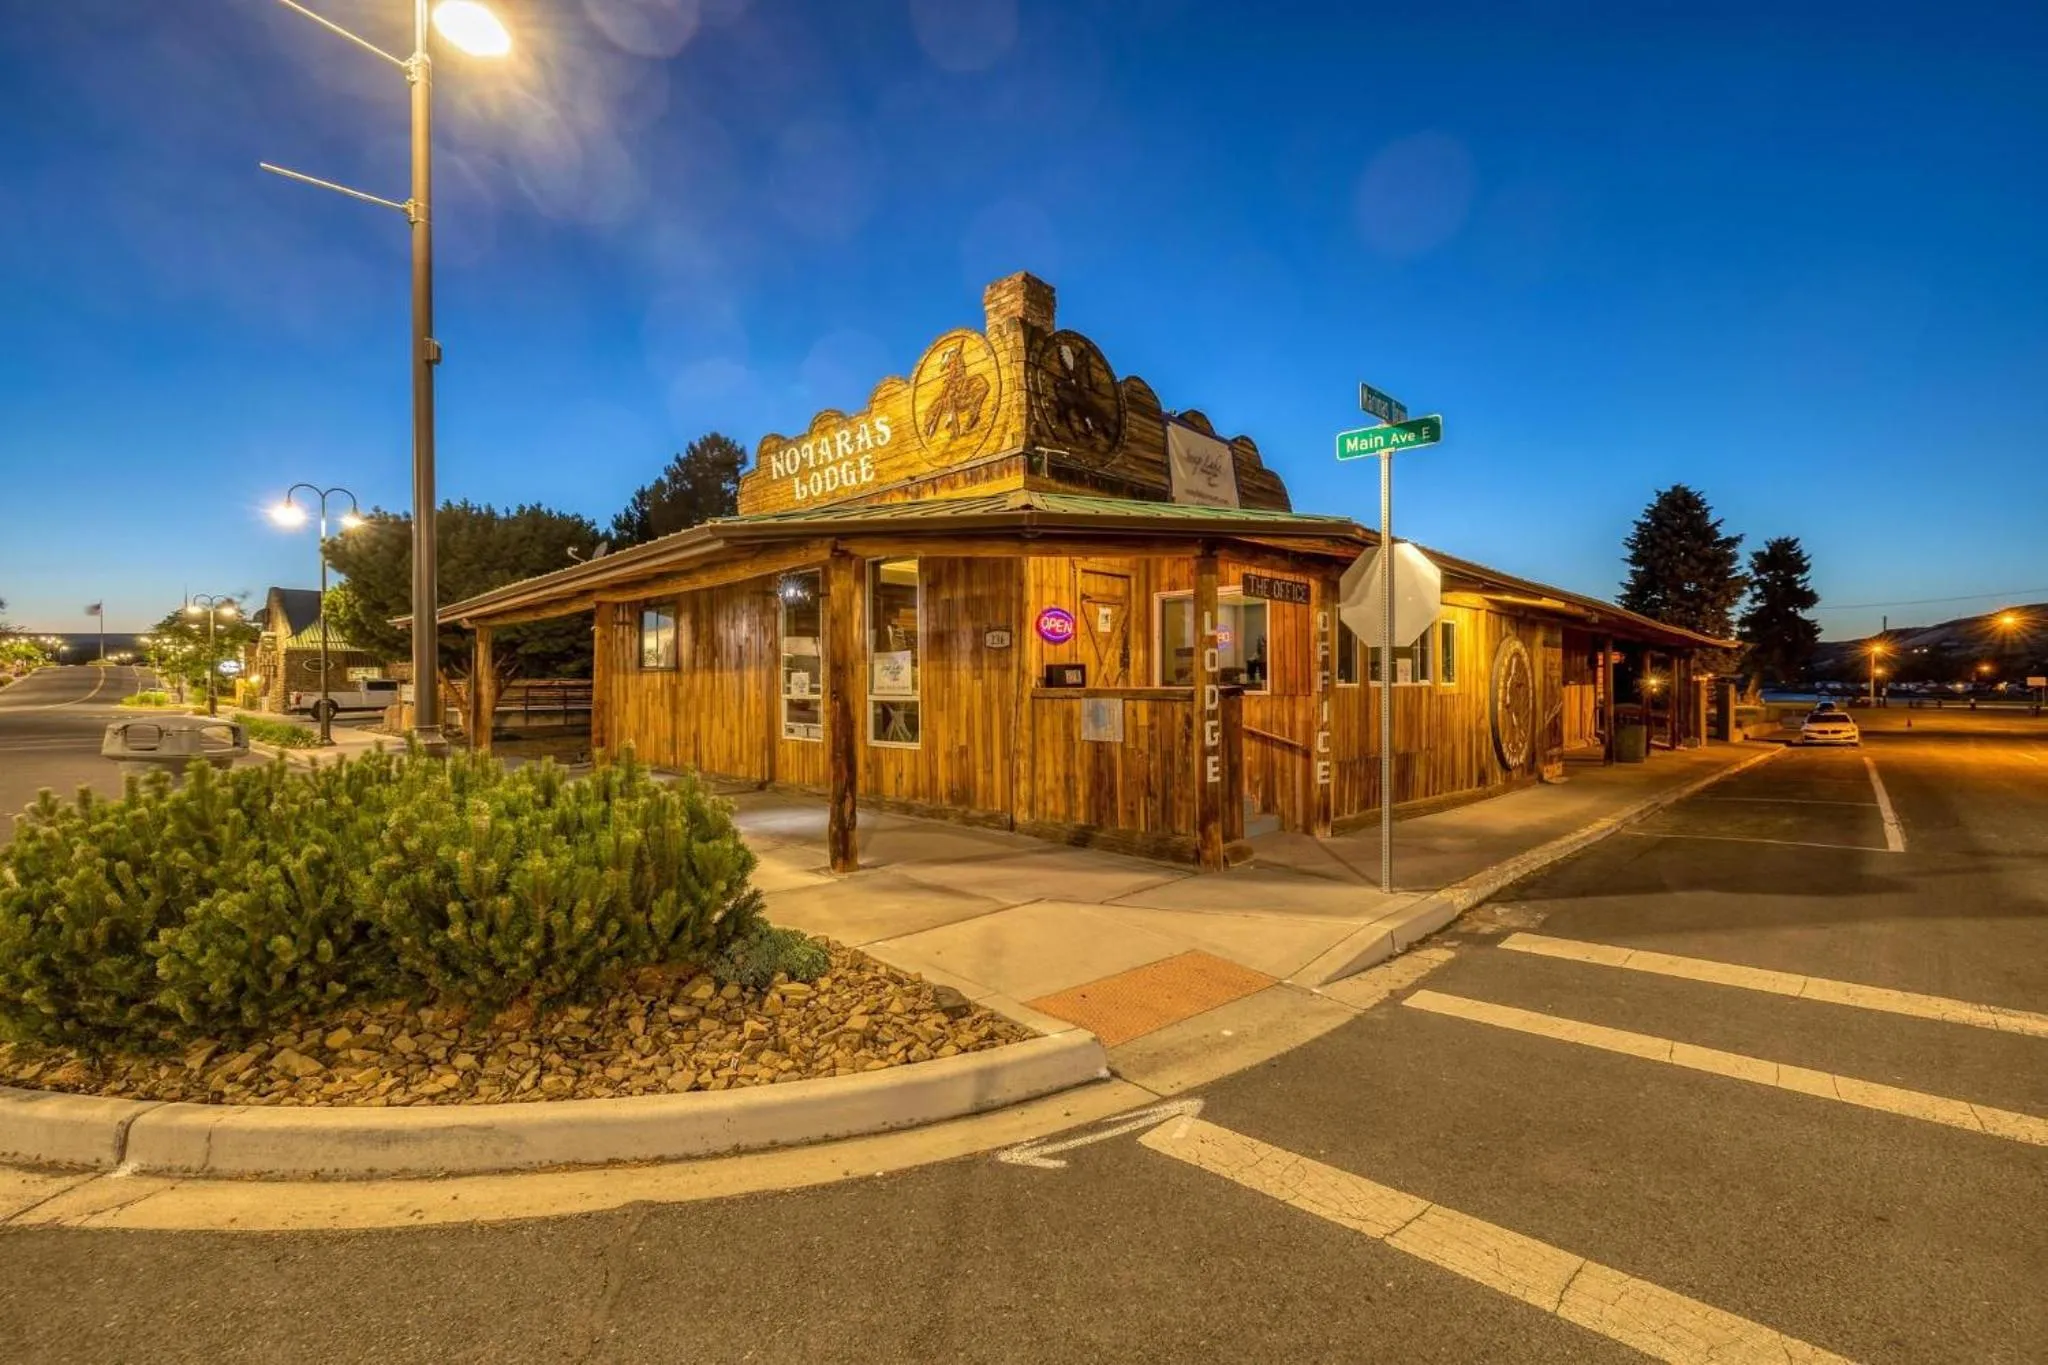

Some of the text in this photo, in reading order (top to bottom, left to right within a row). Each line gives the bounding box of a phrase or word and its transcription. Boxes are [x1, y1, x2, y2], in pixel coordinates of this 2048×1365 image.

[770, 415, 892, 480] NOTARAS
[1346, 426, 1431, 453] Main Ave E
[793, 454, 875, 500] LODGE
[1248, 575, 1308, 603] THE OFFICE
[1040, 616, 1073, 634] OPEN
[1204, 611, 1220, 783] LODGE
[1317, 612, 1330, 785] OFFICE
